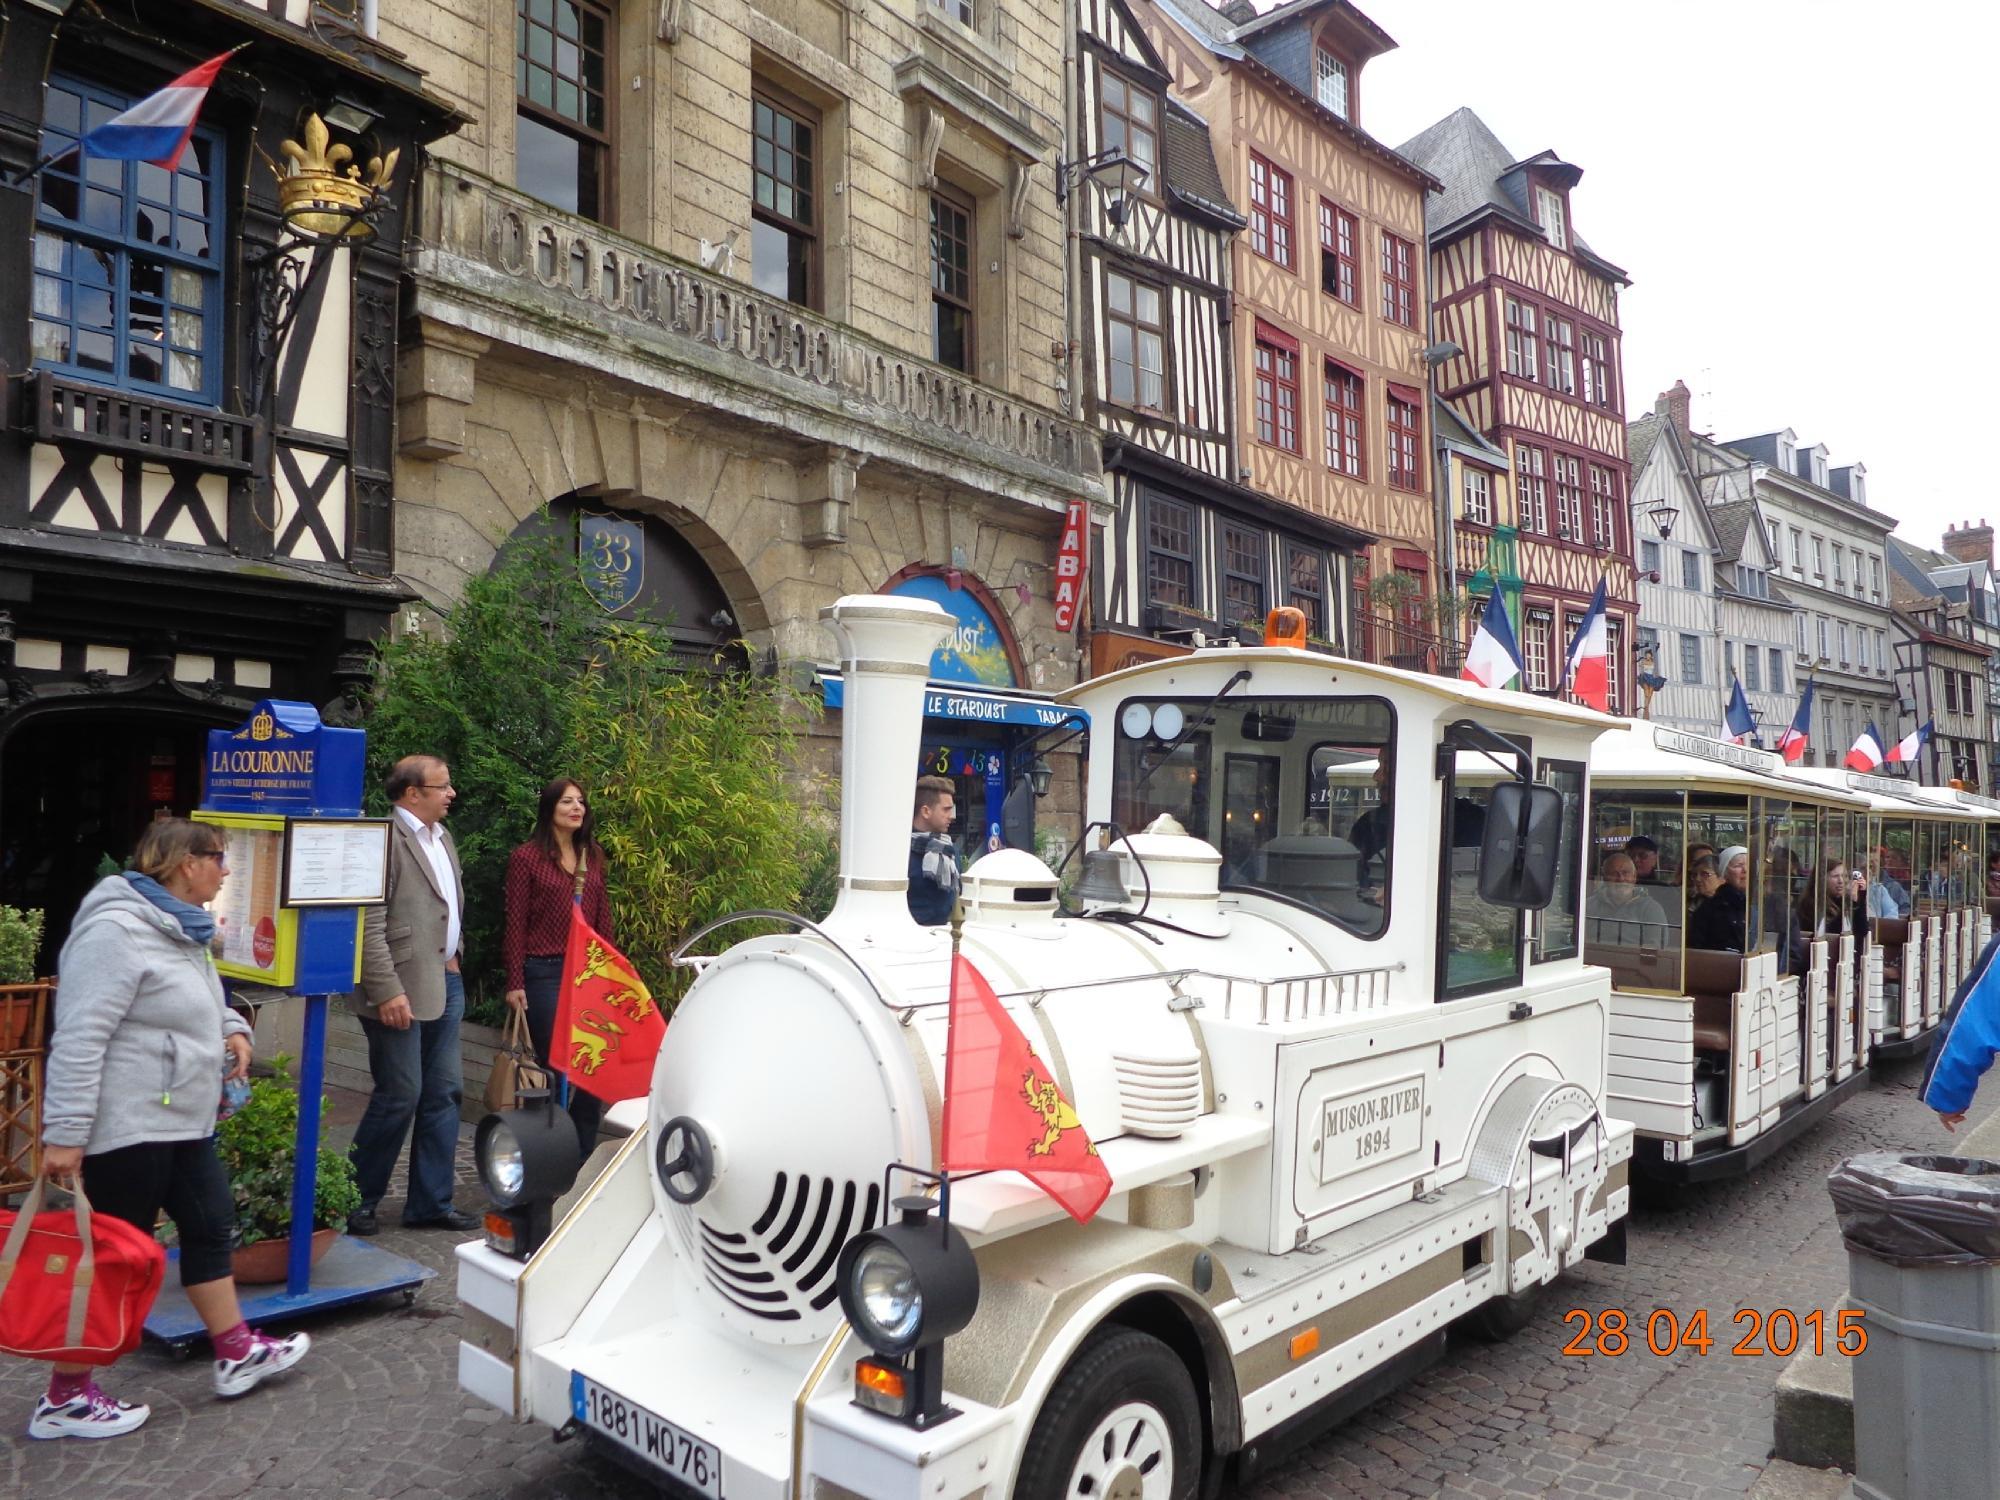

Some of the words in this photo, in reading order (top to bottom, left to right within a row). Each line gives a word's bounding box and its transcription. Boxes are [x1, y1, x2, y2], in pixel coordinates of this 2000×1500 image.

[594, 530, 632, 573] 33
[1056, 504, 1081, 626] TABAC
[928, 696, 942, 713] LE
[947, 698, 1007, 720] STARDUST
[212, 751, 229, 772] LA
[231, 750, 313, 773] COURONNE
[1356, 1126, 1391, 1160] 1894
